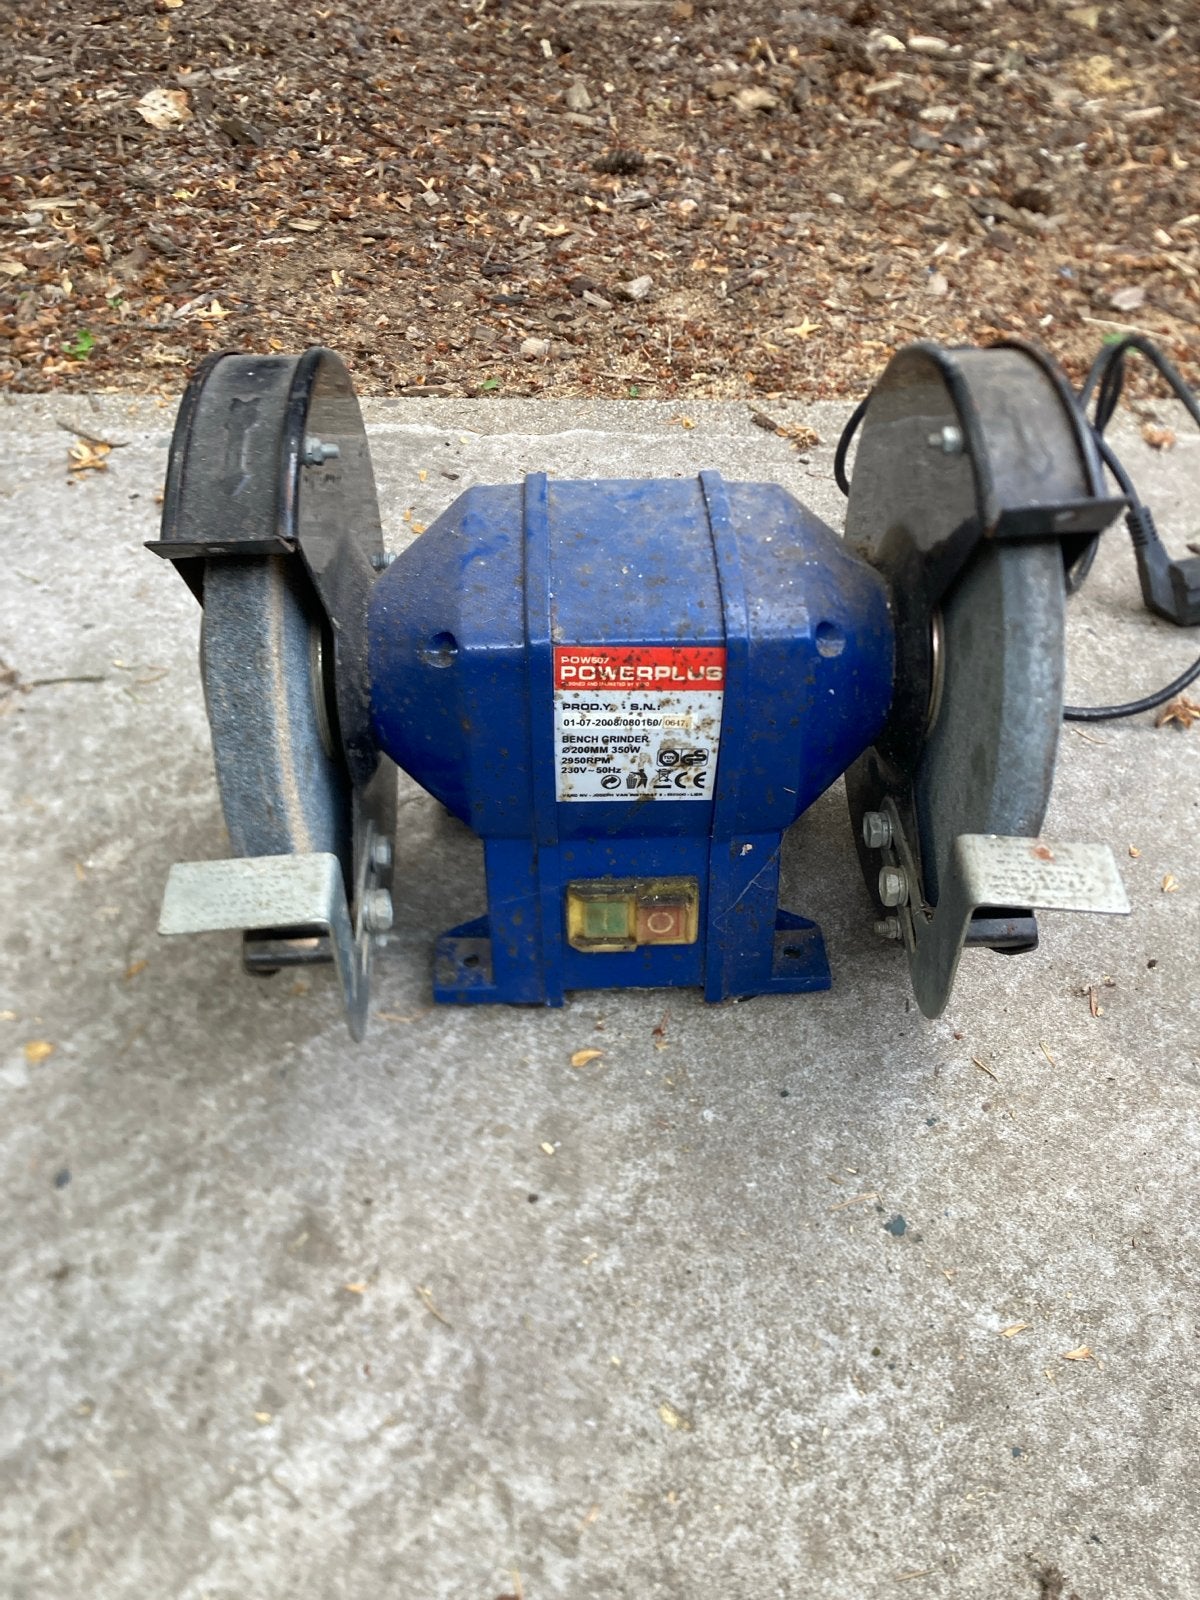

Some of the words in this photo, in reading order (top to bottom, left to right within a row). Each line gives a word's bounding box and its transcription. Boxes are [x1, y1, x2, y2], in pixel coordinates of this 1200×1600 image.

[560, 665, 723, 681] POWERPLUS
[562, 735, 599, 743] BENCH
[601, 735, 650, 743] GRINDER
[611, 746, 641, 754] 350W
[561, 757, 611, 765] 2950RPM
